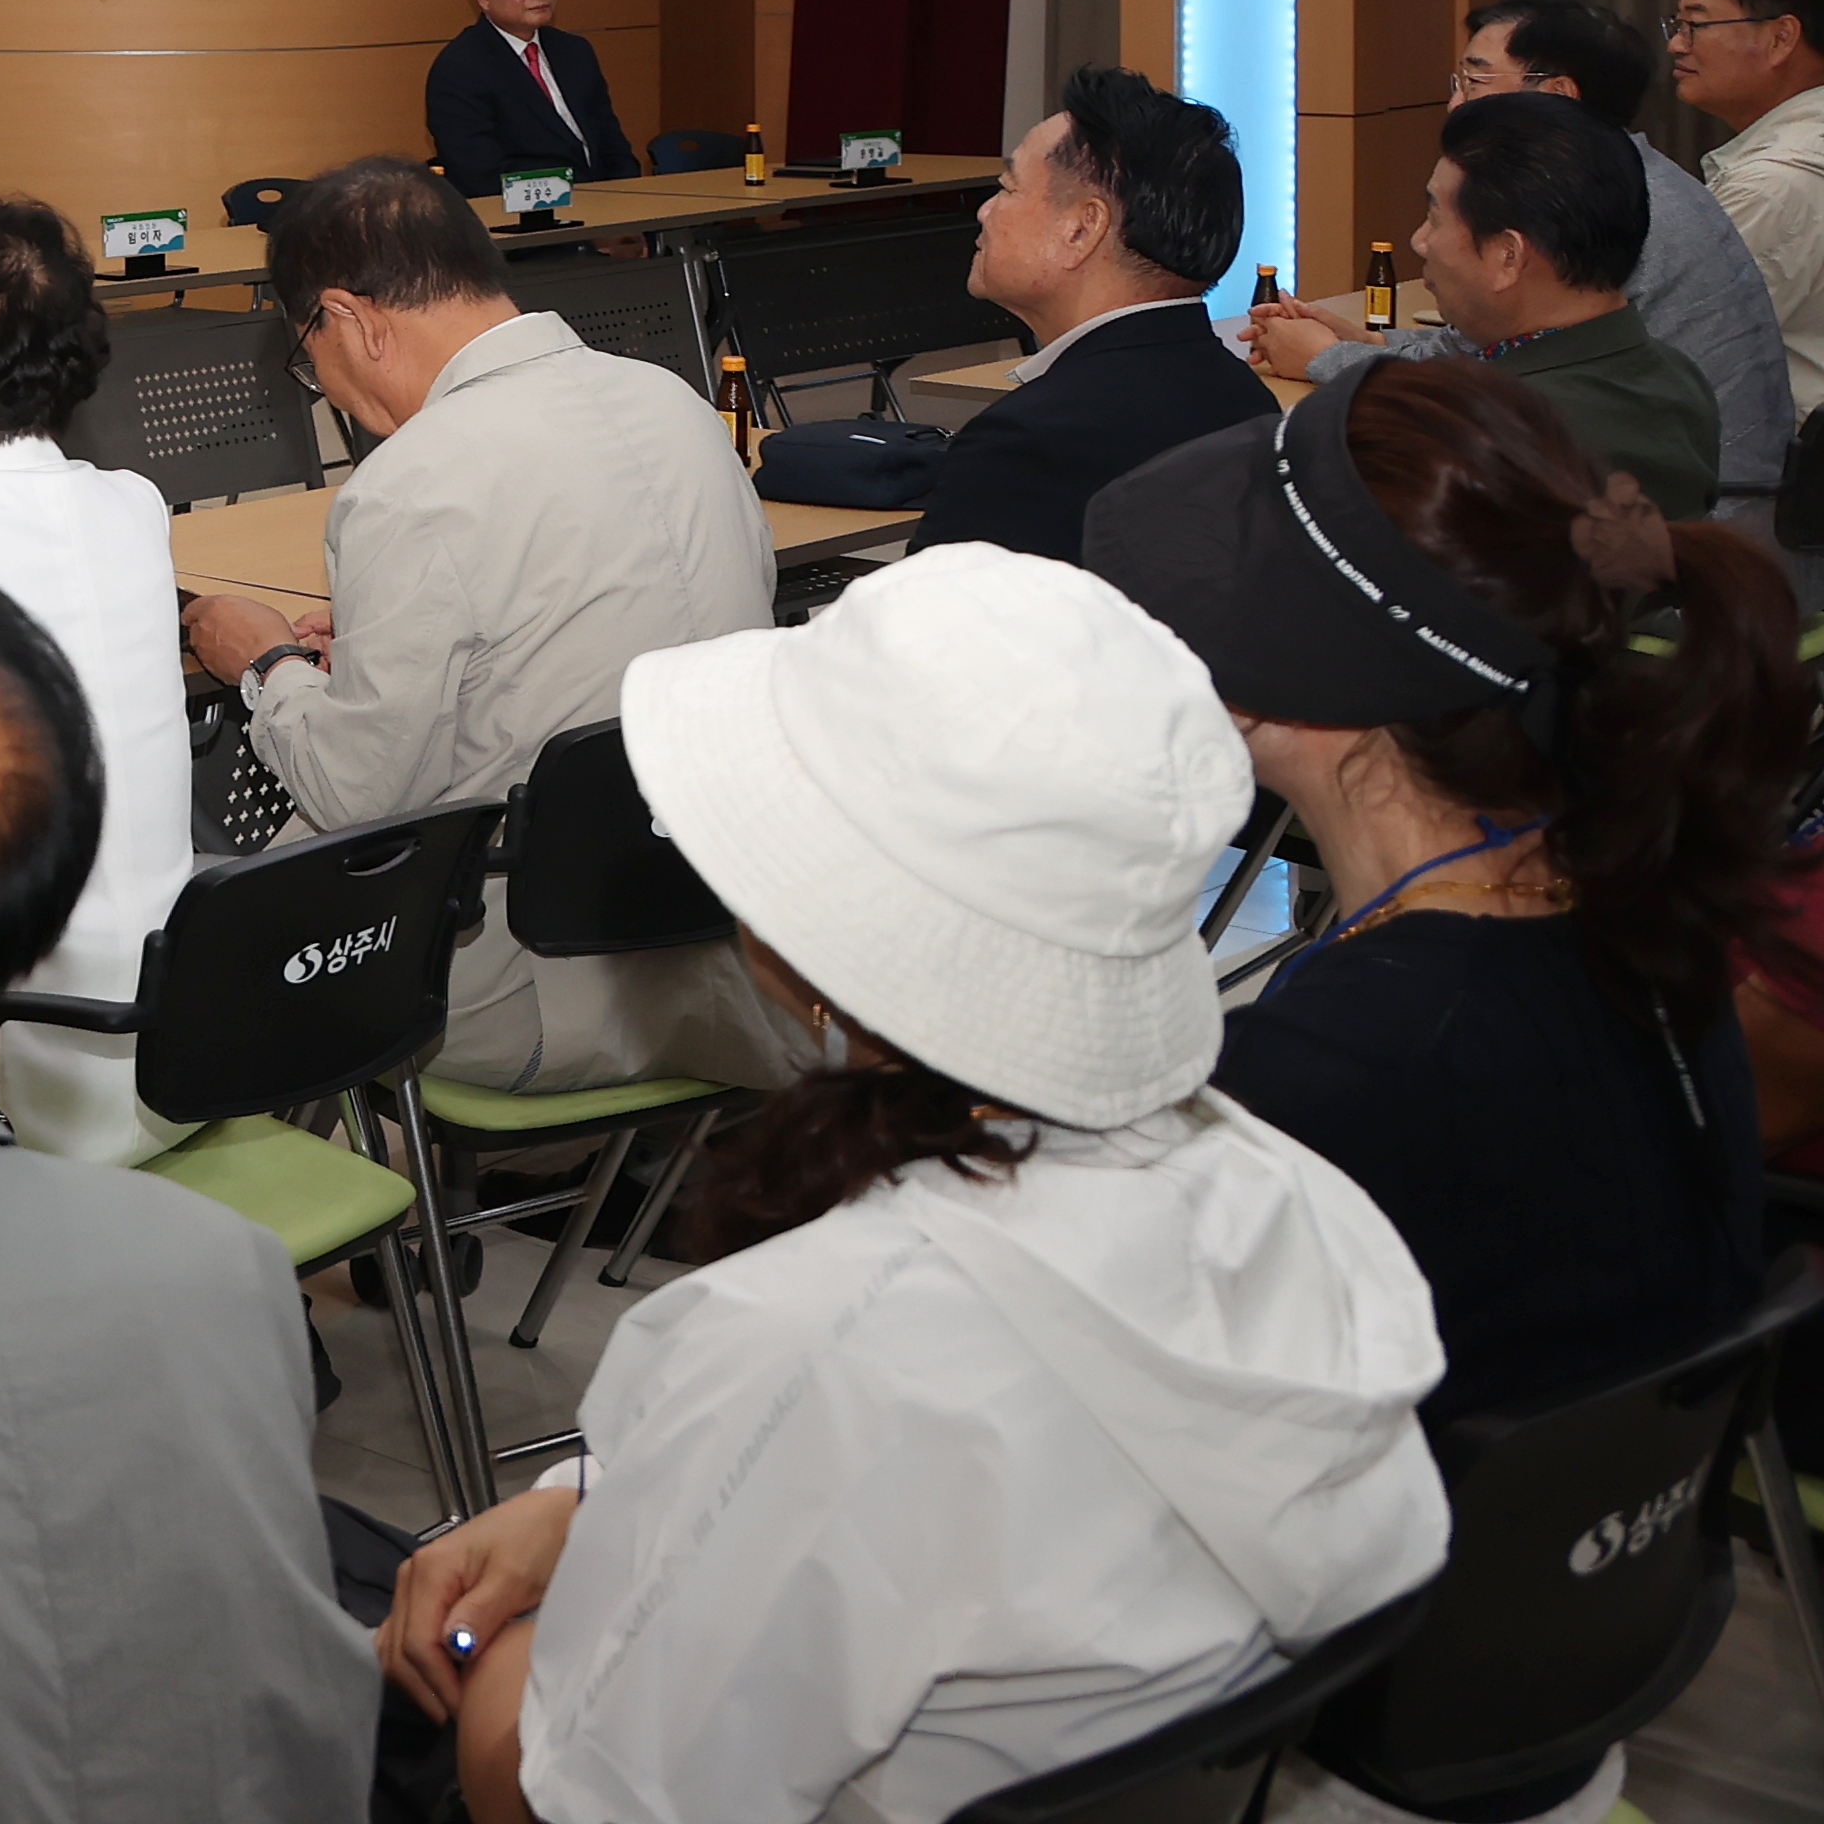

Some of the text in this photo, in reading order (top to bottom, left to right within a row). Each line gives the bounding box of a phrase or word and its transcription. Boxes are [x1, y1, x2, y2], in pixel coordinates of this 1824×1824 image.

[1282, 481, 1312, 524] MASTER
[1304, 519, 1341, 561] BUNNY
[1335, 557, 1384, 604] EDITION
[1415, 625, 1515, 688] MASTER BUNNY
[325, 915, 399, 976] 상주시
